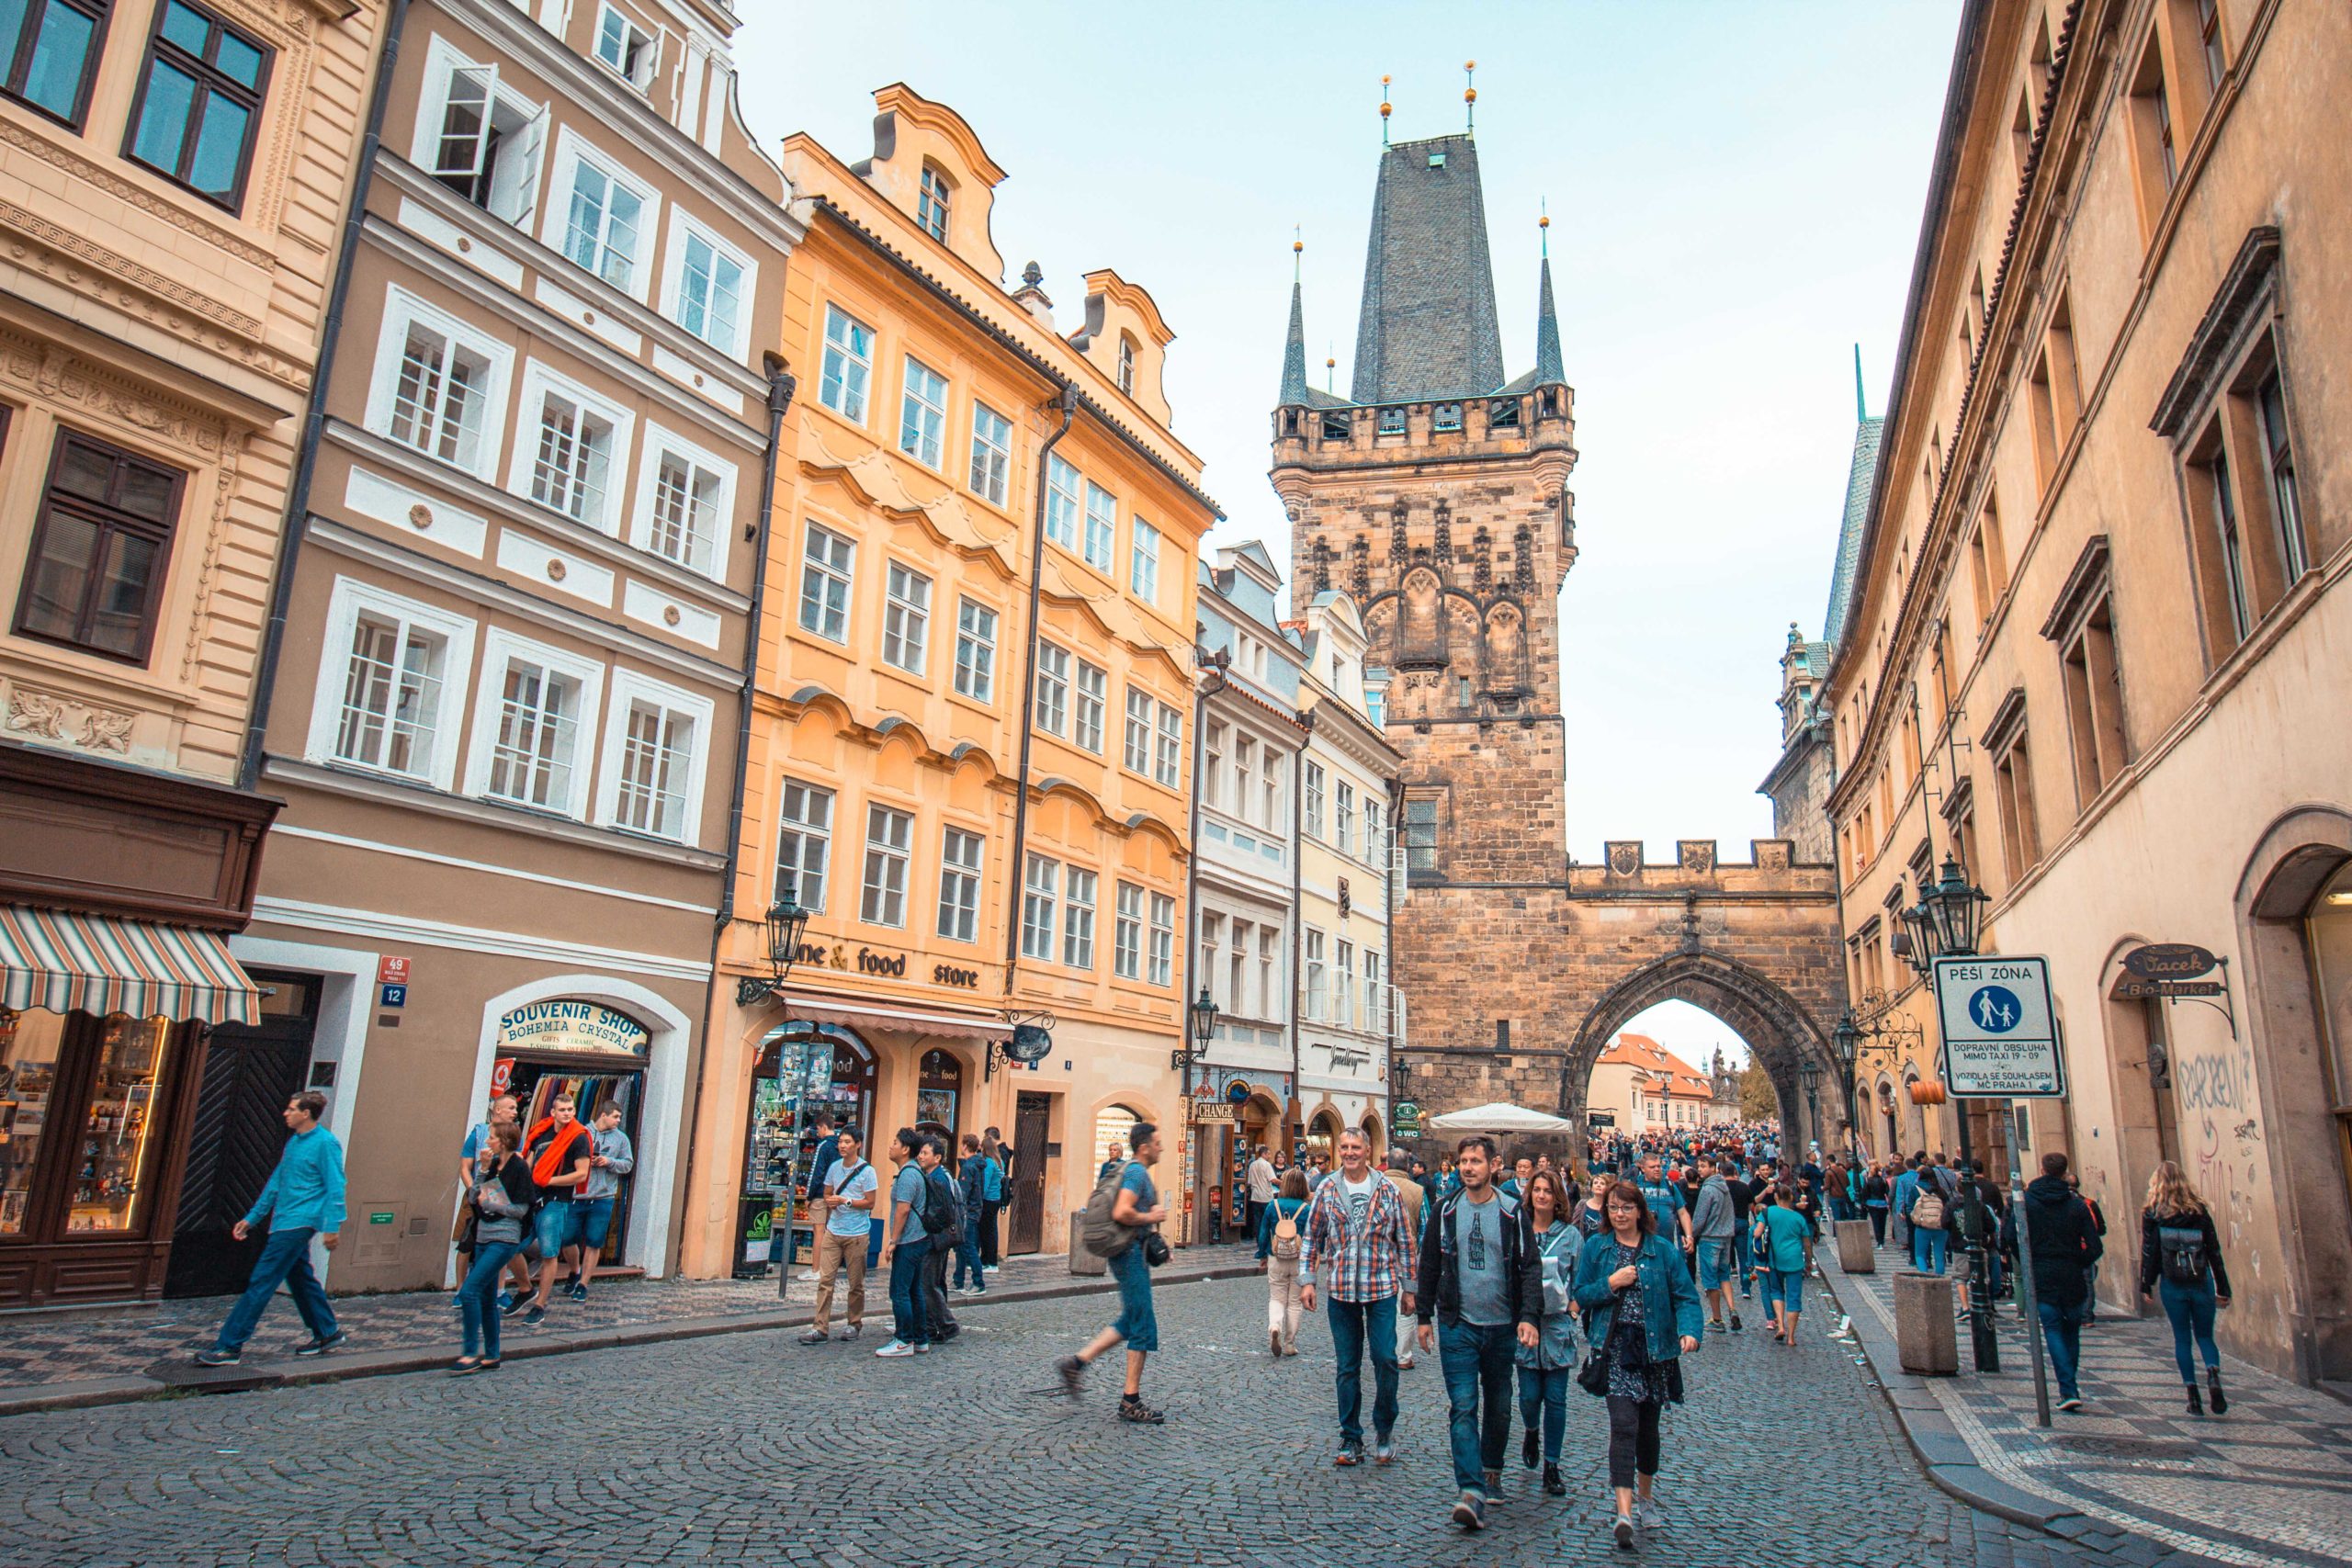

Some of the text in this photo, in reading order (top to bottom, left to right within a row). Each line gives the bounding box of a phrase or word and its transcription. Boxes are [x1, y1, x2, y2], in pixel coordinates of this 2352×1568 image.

[390, 959, 402, 970] 49
[830, 944, 848, 970] &
[857, 946, 907, 976] food
[933, 964, 978, 987] store
[1950, 964, 2032, 980] PĚŠÍ ZÓNA
[388, 988, 401, 1002] 12
[501, 1003, 641, 1038] SOUVENIR SHOP
[508, 1021, 628, 1050] BOHEMIA CRYSTAL
[541, 1035, 596, 1046] GIFTS CERAMIC
[1953, 1043, 2048, 1052] DOPRAVNÍ OBSLUHA
[1988, 1052, 2009, 1060] TAXI
[2012, 1052, 2019, 1060] 19
[941, 1069, 957, 1080] food
[1955, 1072, 2052, 1080] VOZIDLA SE SOUHLASEM
[1977, 1079, 1991, 1089] MČ
[1198, 1103, 1234, 1118] CHANGE
